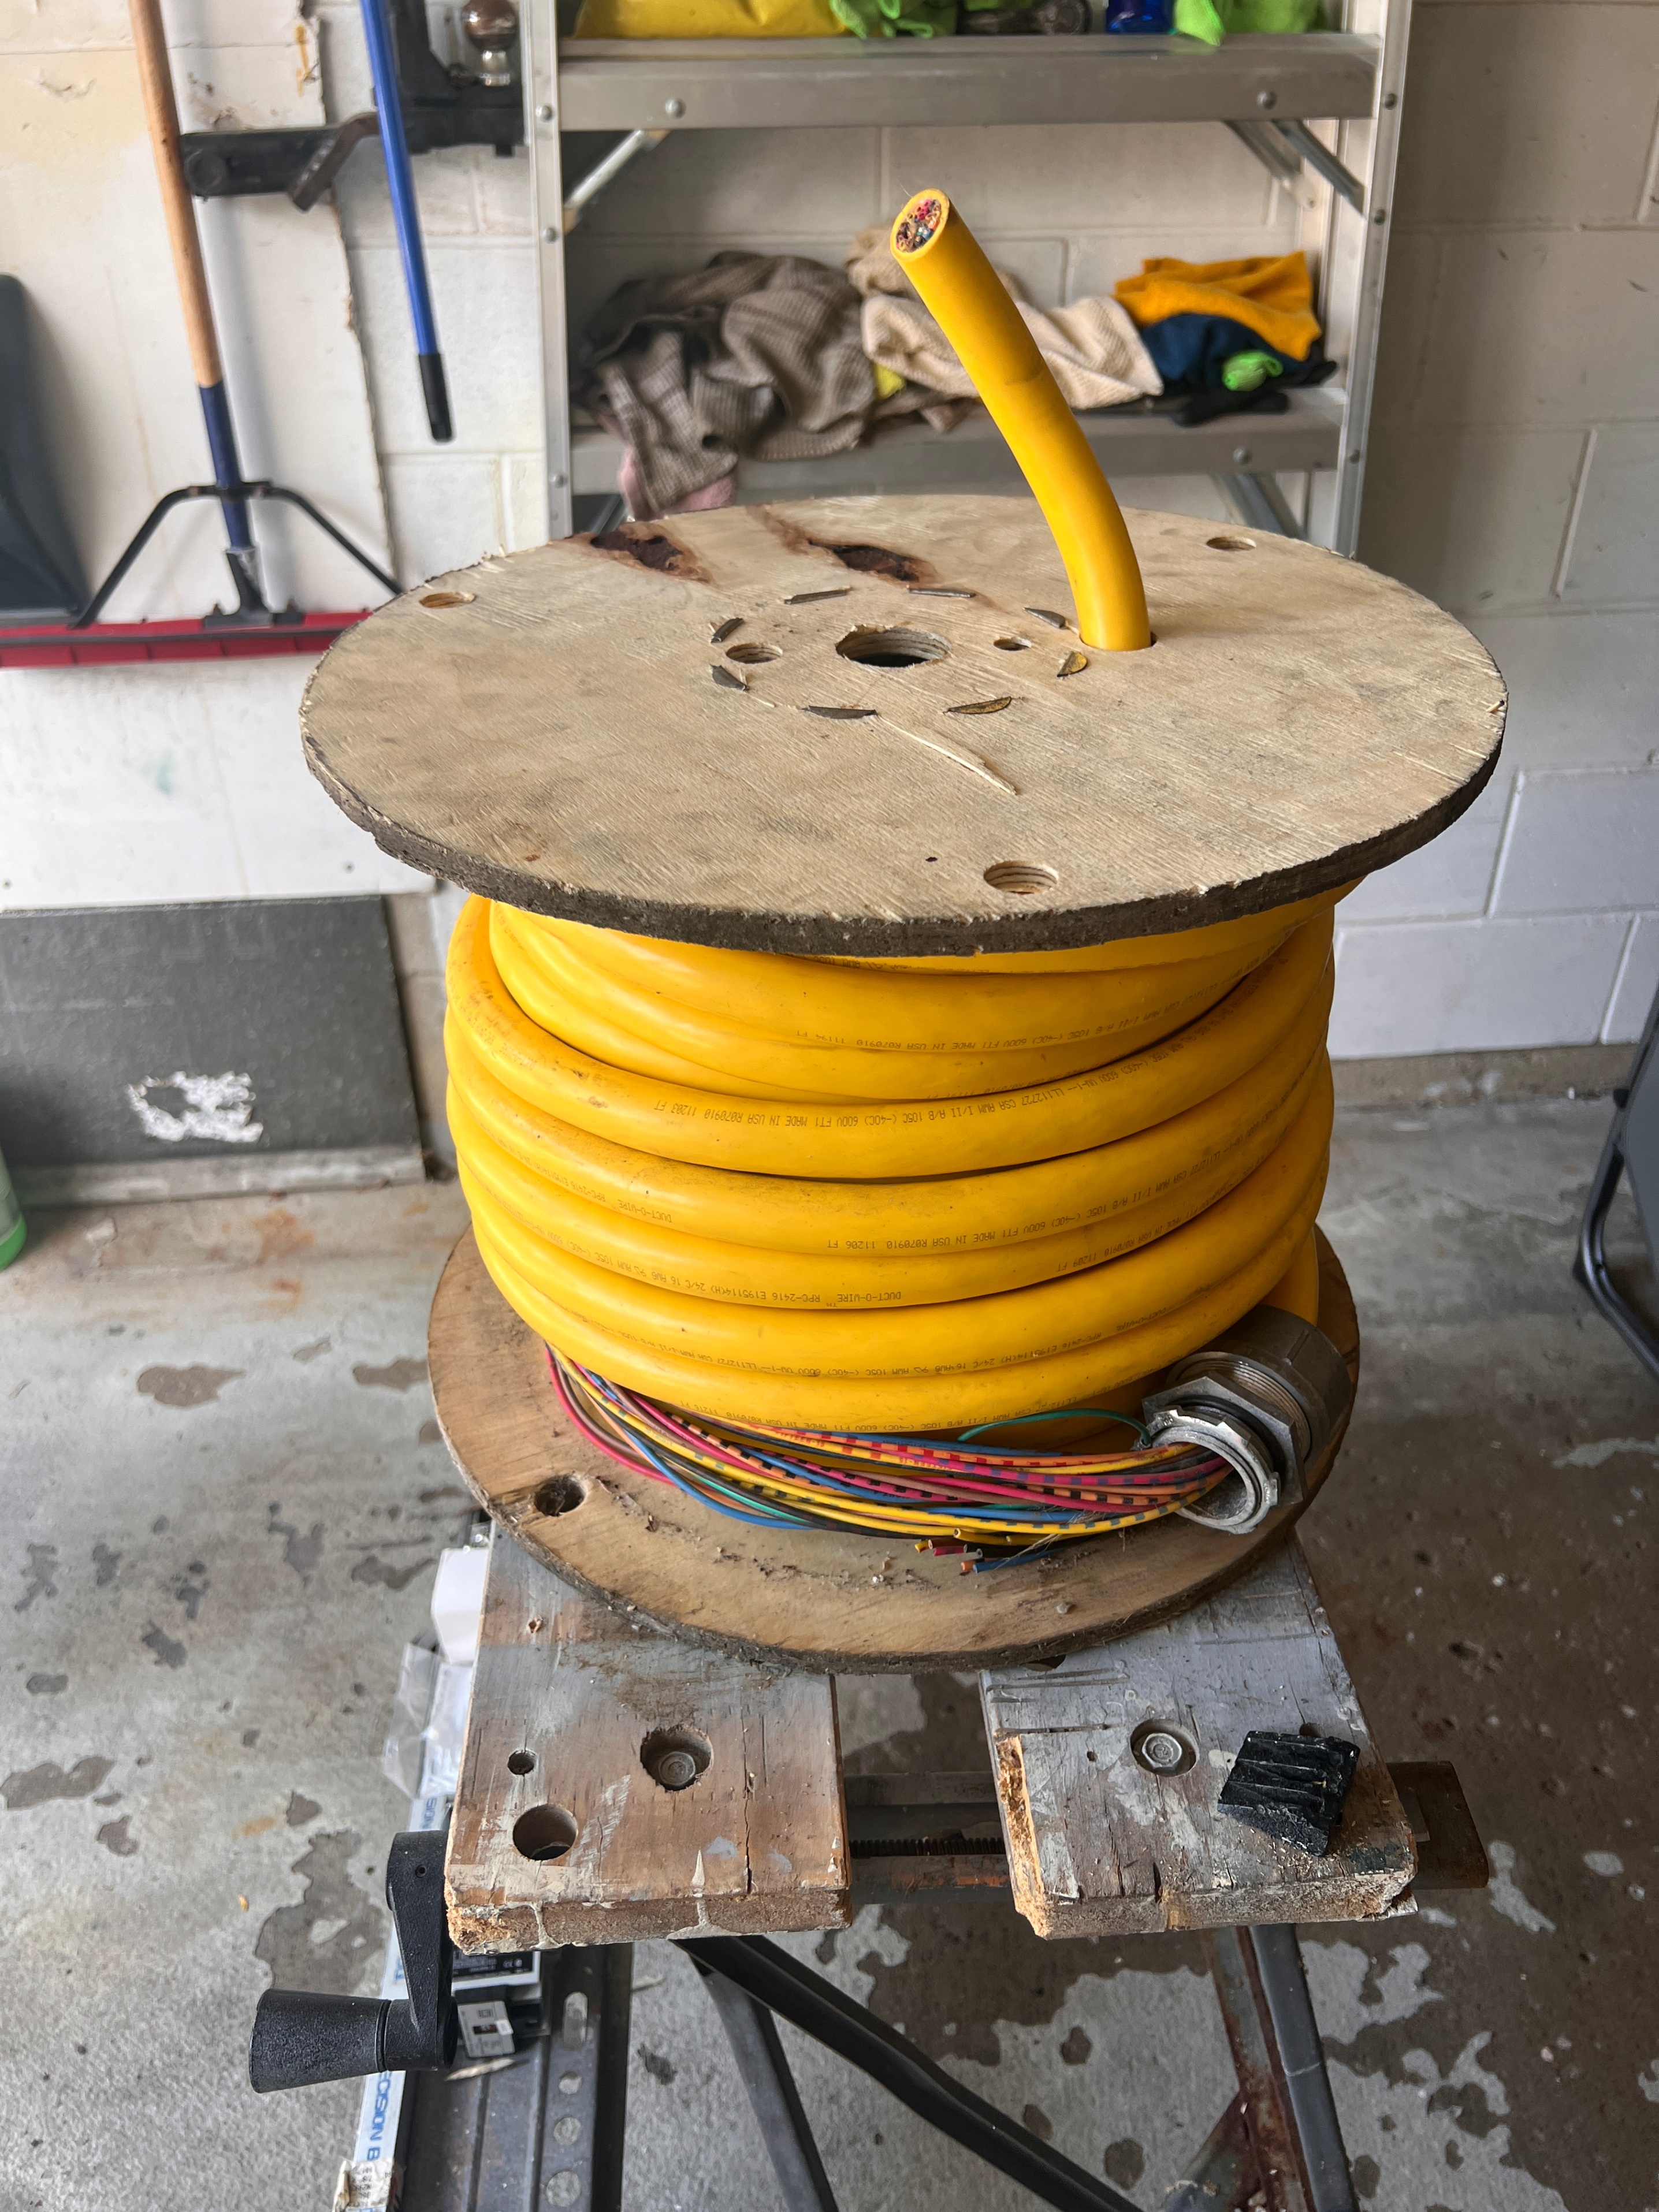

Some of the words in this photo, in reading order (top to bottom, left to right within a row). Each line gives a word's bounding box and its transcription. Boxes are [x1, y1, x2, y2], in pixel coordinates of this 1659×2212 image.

[794, 1030, 808, 1038] FT
[814, 1034, 845, 1044] 11194
[1068, 1029, 1090, 1040] 105C
[855, 1040, 902, 1049] R070910
[906, 1042, 927, 1051] USA
[952, 1042, 976, 1051] MADE
[1002, 1038, 1026, 1048] 600V
[1020, 1088, 1066, 1106] LL112727
[653, 1100, 667, 1113] FT
[670, 1103, 697, 1118] 11203
[977, 1102, 996, 1114] AWM
[998, 1100, 1017, 1110] CSA
[704, 1108, 743, 1124] R070910
[927, 1109, 946, 1121] A/B
[949, 1106, 974, 1118] I/II
[746, 1114, 765, 1125] USA
[769, 1115, 780, 1127] IN
[784, 1115, 808, 1127] MADE
[815, 1117, 832, 1128] FT1
[836, 1116, 858, 1127] 600V
[863, 1114, 897, 1126] (-40C)
[901, 1112, 924, 1124] 105C
[1112, 1197, 1128, 1211] A/B
[1085, 1205, 1107, 1219] 105C
[1050, 1212, 1081, 1228] (-40C)
[1002, 1228, 1018, 1238] FT1
[1022, 1222, 1045, 1235] 600V
[931, 1237, 951, 1247] USA
[955, 1235, 967, 1245] IN
[972, 1231, 996, 1243] MADE
[826, 1240, 838, 1249] FT
[844, 1240, 876, 1250] 11206
[885, 1239, 928, 1249] R070910
[594, 1252, 613, 1265] 105C
[1072, 1253, 1097, 1268] 11209
[1057, 1261, 1068, 1273] FT
[650, 1271, 667, 1283] AWG
[669, 1276, 681, 1287] 16
[685, 1279, 706, 1293] 24/C
[711, 1284, 767, 1301] E195114(H)
[771, 1292, 821, 1302] RPC-2416
[956, 1362, 966, 1372] 16
[972, 1358, 995, 1369] 24/C
[797, 1367, 821, 1377] 600V
[827, 1368, 860, 1376] (-40C)
[865, 1368, 887, 1376] 105C
[891, 1367, 909, 1376] AWM
[679, 1400, 690, 1409] FT
[693, 1405, 719, 1415] 11216
[725, 1411, 762, 1423] R070910
[992, 1414, 1010, 1422] AWM
[920, 1422, 942, 1431] 105C
[947, 1420, 964, 1428] A/B
